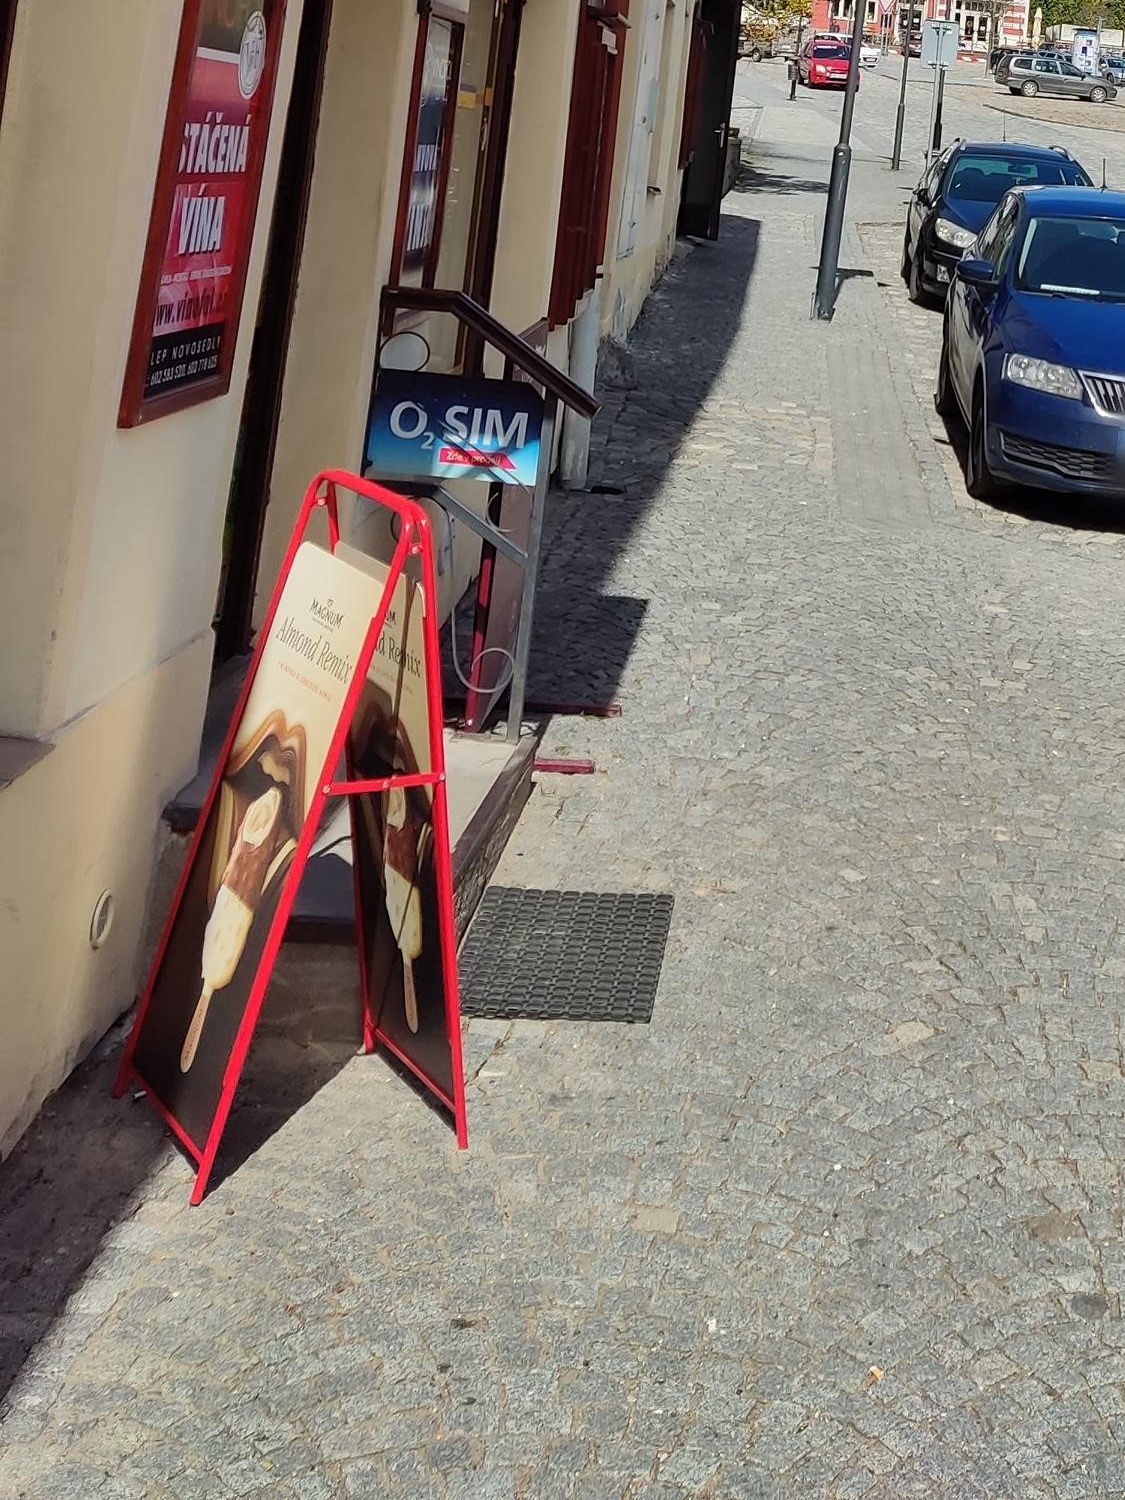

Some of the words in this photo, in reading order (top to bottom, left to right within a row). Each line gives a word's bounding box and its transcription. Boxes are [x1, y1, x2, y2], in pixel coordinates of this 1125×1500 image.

[178, 183, 226, 255] VÍNA
[442, 404, 529, 450] SIM
[309, 599, 345, 629] MAGNUM
[275, 617, 320, 663] Almond
[316, 640, 353, 685] Remix
